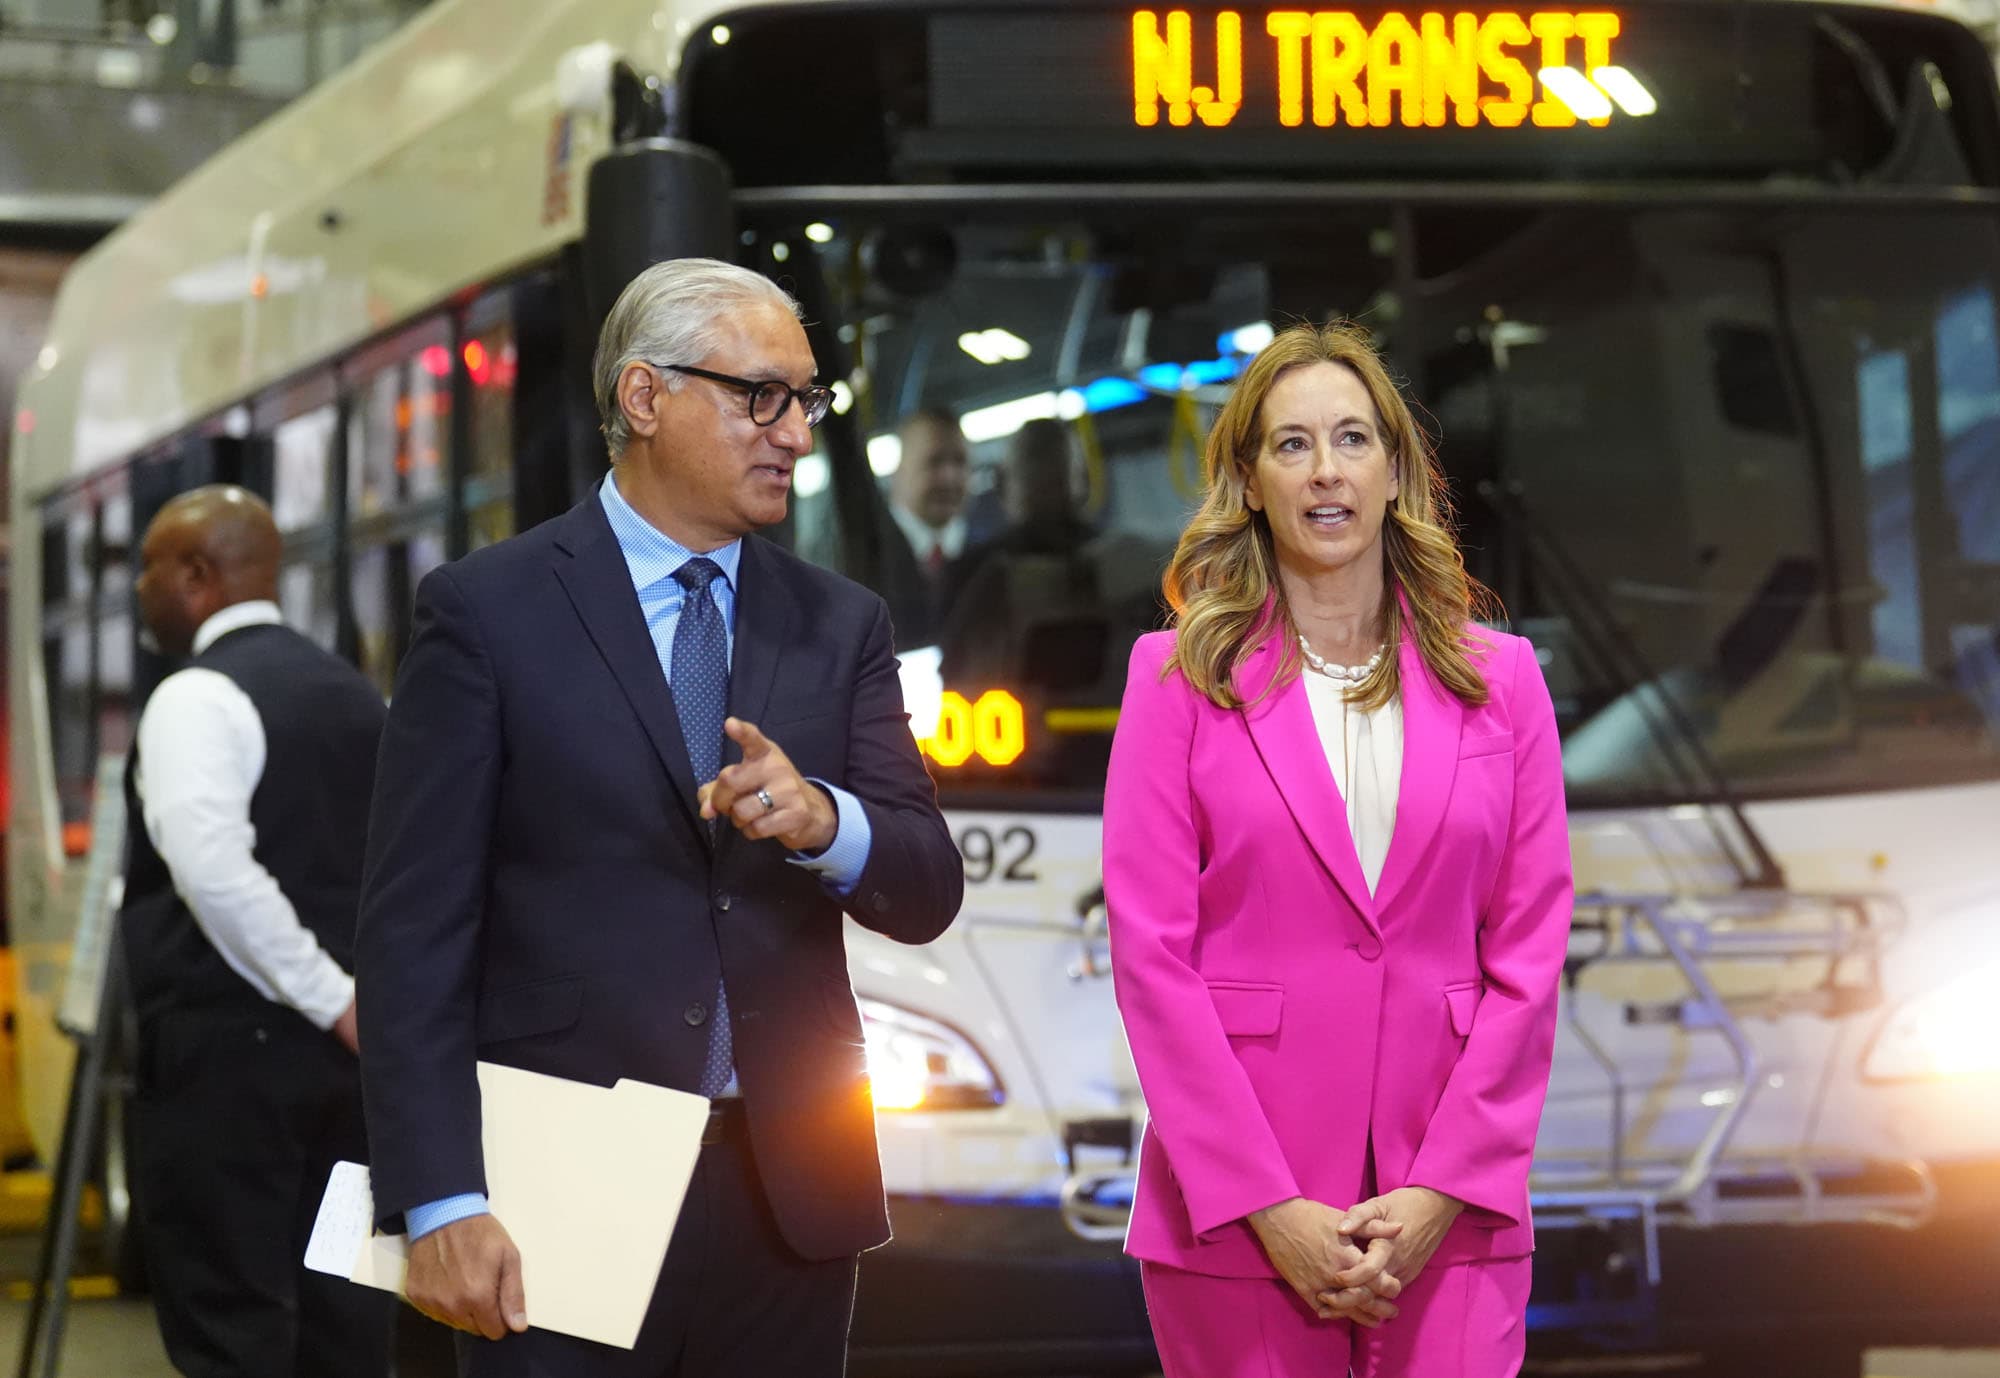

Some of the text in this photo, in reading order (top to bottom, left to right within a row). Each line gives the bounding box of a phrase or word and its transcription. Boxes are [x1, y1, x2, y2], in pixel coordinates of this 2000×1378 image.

[1132, 11, 1621, 128] NJ TRANSIT
[917, 689, 1025, 767] 00
[960, 826, 1037, 884] 92
